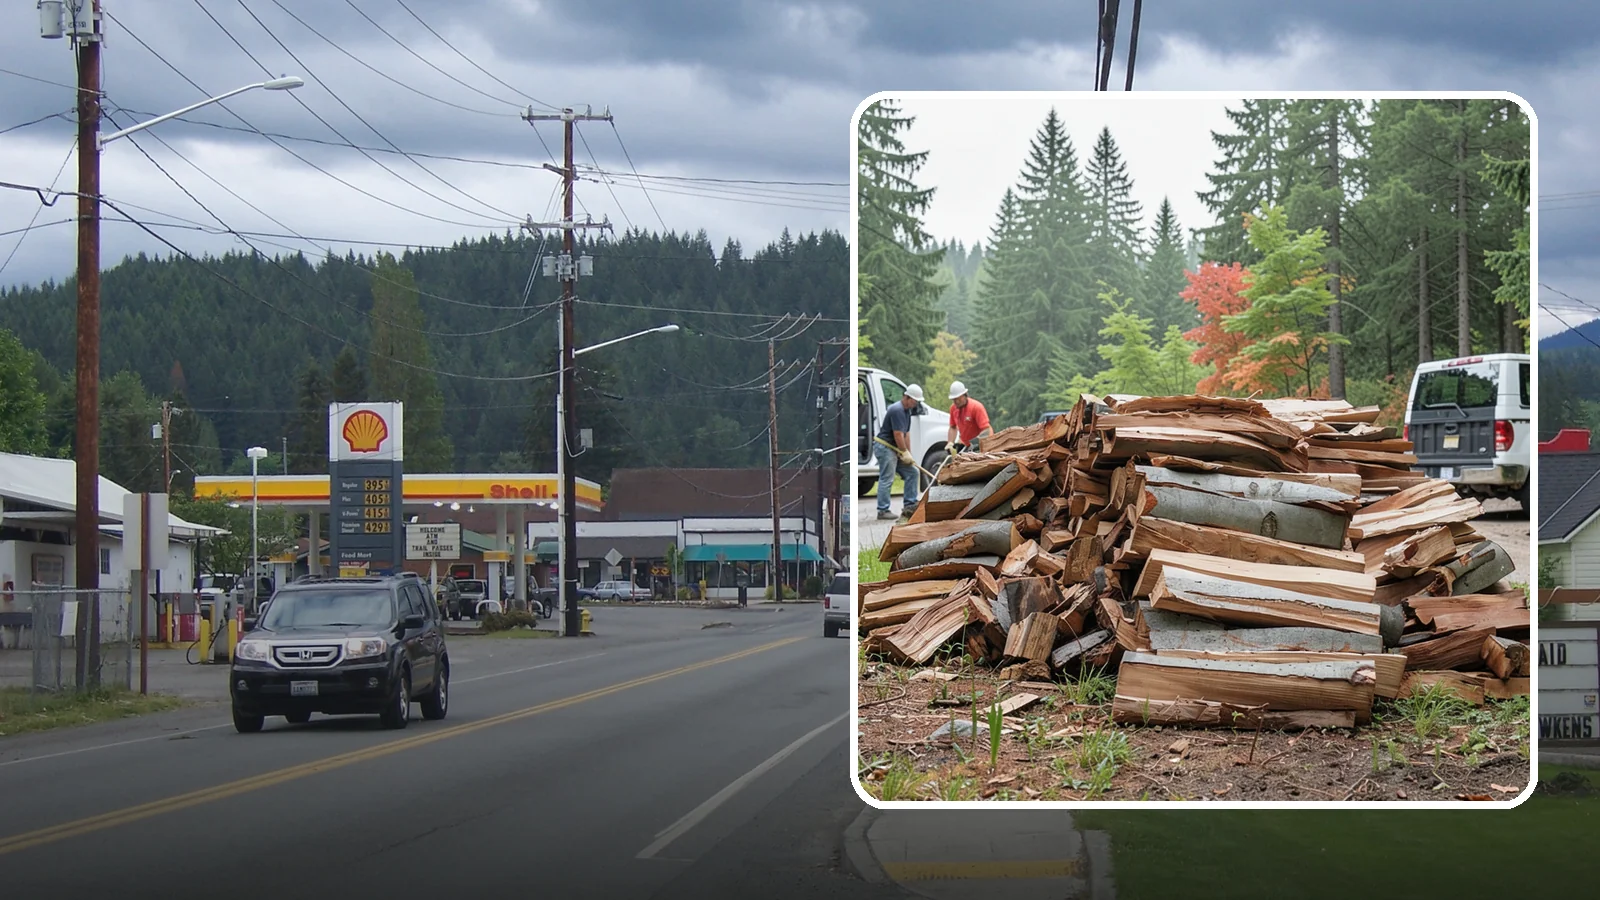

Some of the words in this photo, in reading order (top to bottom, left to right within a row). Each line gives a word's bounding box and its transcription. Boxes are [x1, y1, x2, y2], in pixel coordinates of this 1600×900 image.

[366, 480, 383, 490] 395
[490, 484, 547, 499] Shell
[366, 494, 383, 504] 405
[366, 508, 383, 518] 415
[366, 522, 383, 533] 429
